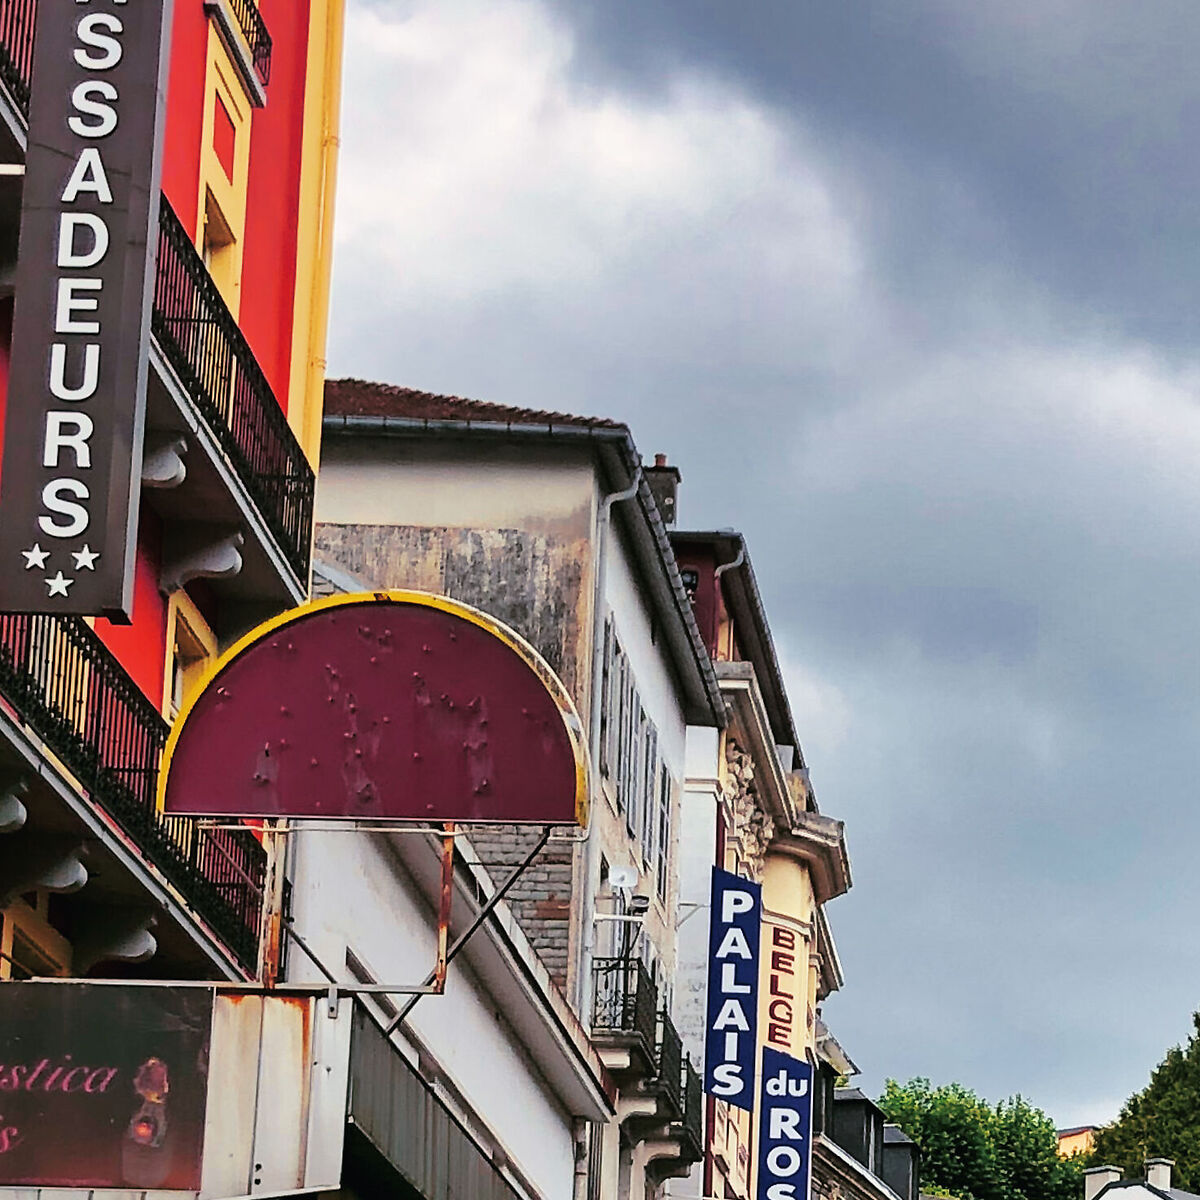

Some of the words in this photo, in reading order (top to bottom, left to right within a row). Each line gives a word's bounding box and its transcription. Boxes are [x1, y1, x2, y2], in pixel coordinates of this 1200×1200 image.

[38, 0, 127, 538] SSADEURS
[711, 889, 755, 1097] PALAIS
[767, 926, 796, 1049] BELGE
[765, 1069, 809, 1097] du
